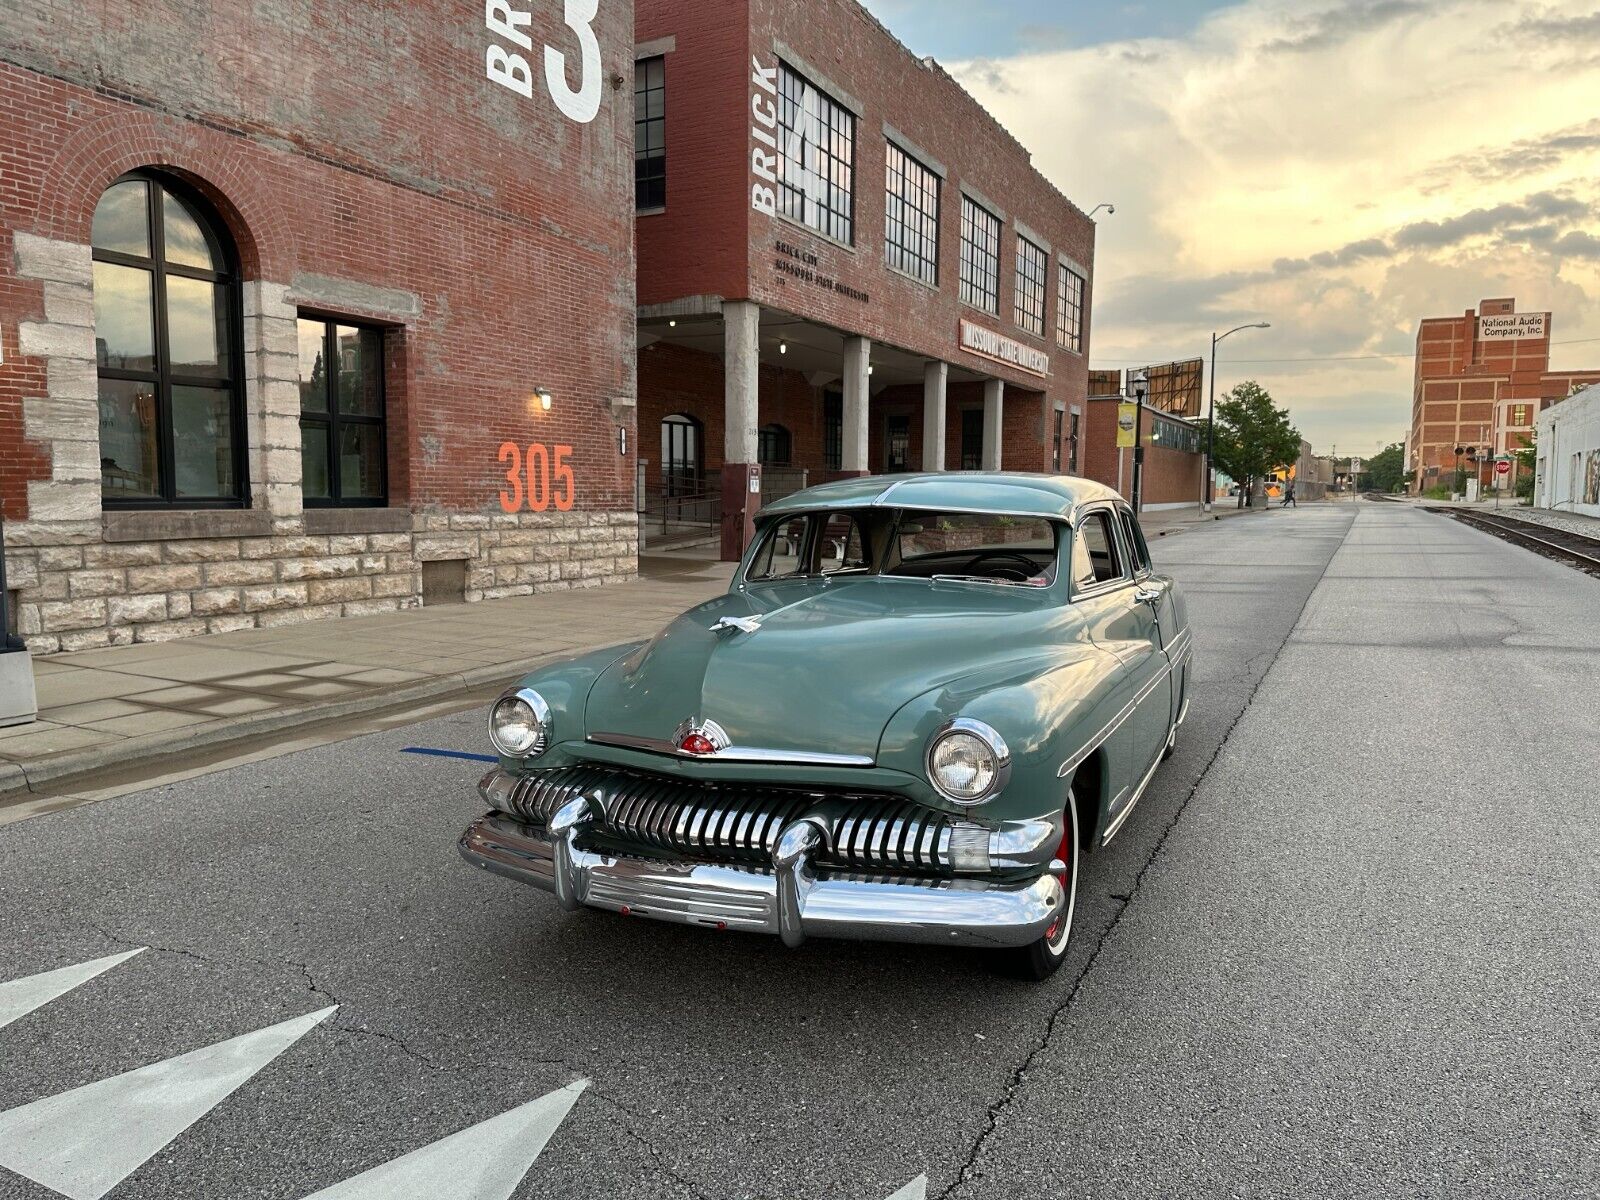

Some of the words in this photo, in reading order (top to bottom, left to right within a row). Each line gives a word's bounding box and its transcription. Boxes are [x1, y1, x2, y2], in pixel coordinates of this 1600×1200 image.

[486, 0, 532, 99] BR
[752, 54, 776, 218] BRICK
[785, 82, 826, 229] 4
[775, 259, 813, 281] MISSOURI
[776, 240, 799, 259] BRICK
[963, 322, 999, 356] MISSOURI
[1000, 337, 1019, 364] STATE
[1018, 345, 1050, 375] UNIVERSITY
[1481, 317, 1516, 327] National
[1518, 317, 1542, 326] Audio
[1484, 327, 1525, 337] Company,
[1527, 326, 1543, 334] Inc.
[498, 441, 575, 512] 305
